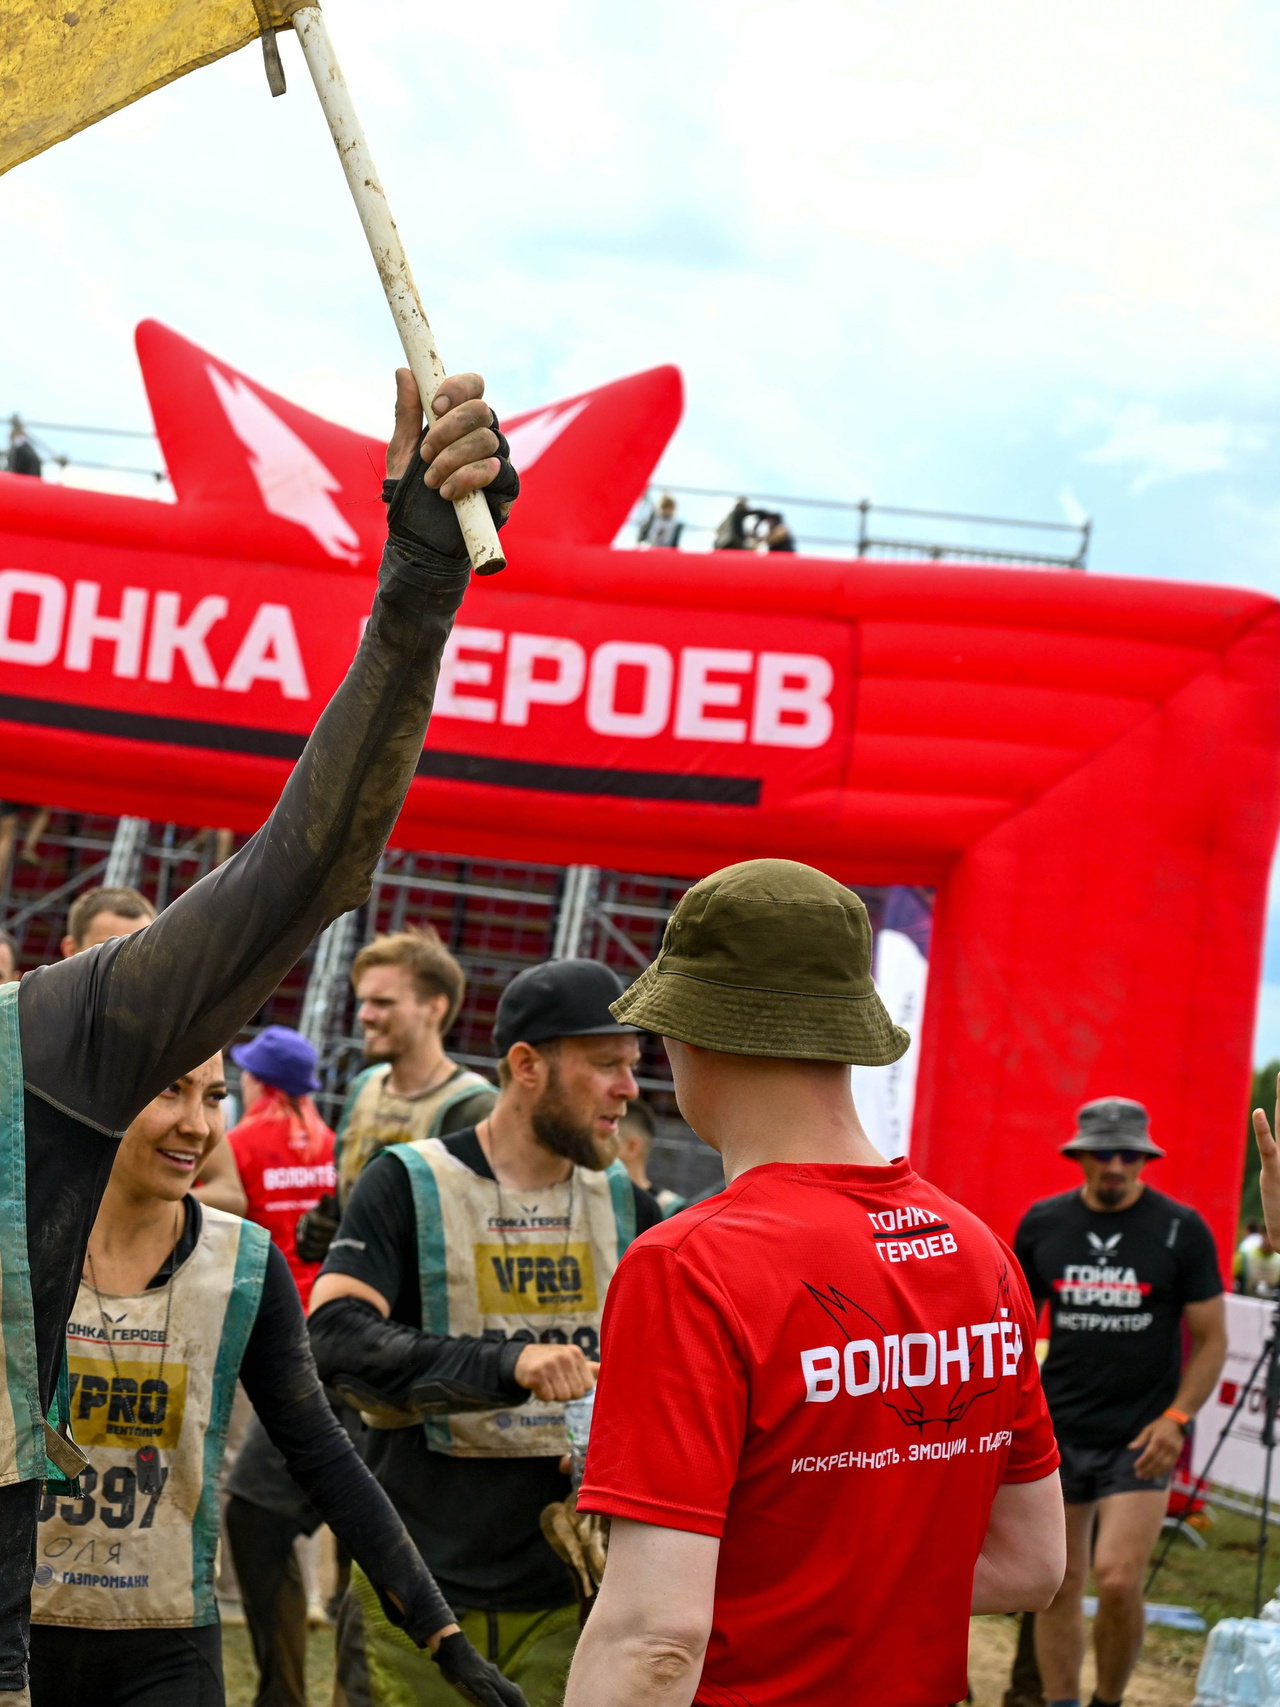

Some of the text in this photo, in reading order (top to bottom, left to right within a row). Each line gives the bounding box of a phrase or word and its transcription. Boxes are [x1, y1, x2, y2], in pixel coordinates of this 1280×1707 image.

[360, 613, 834, 749] ЕРОЕВ
[867, 1206, 942, 1231] ГОНКА
[875, 1232, 958, 1263] ГЕРОЕВ
[491, 1256, 582, 1293] VPRO
[1064, 1264, 1138, 1285] ГОНКА
[67, 1322, 167, 1342] ОНКА ГЕРОЕВ
[63, 1572, 149, 1588] ГАЗПРОМБАНК
